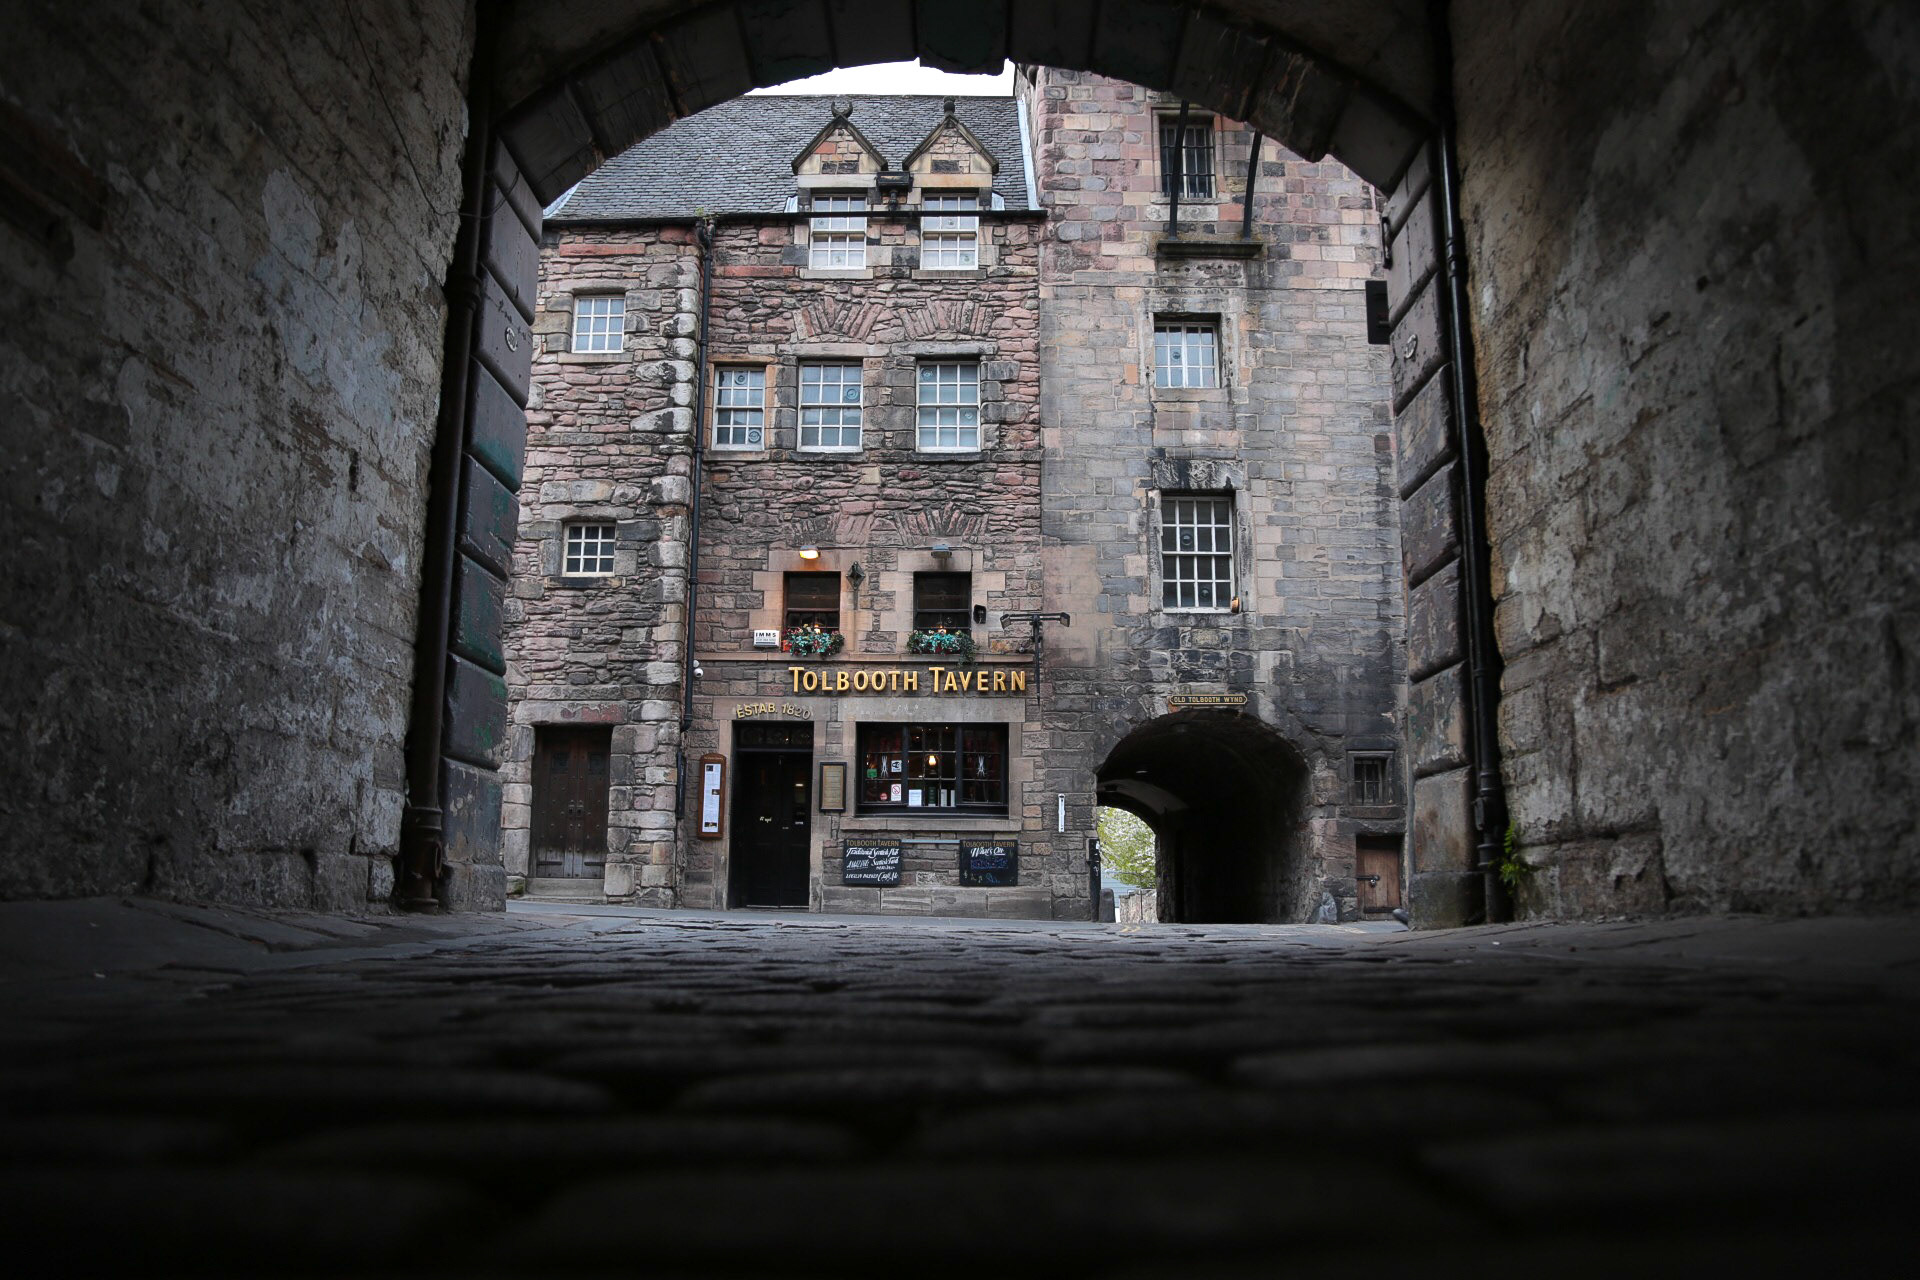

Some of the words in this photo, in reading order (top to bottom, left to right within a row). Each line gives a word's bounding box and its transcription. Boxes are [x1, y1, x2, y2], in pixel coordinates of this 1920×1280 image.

[788, 666, 918, 693] TOLBOOTH
[928, 666, 1026, 693] TAVERN
[736, 702, 778, 719] ESTAB.
[782, 703, 811, 720] 1820
